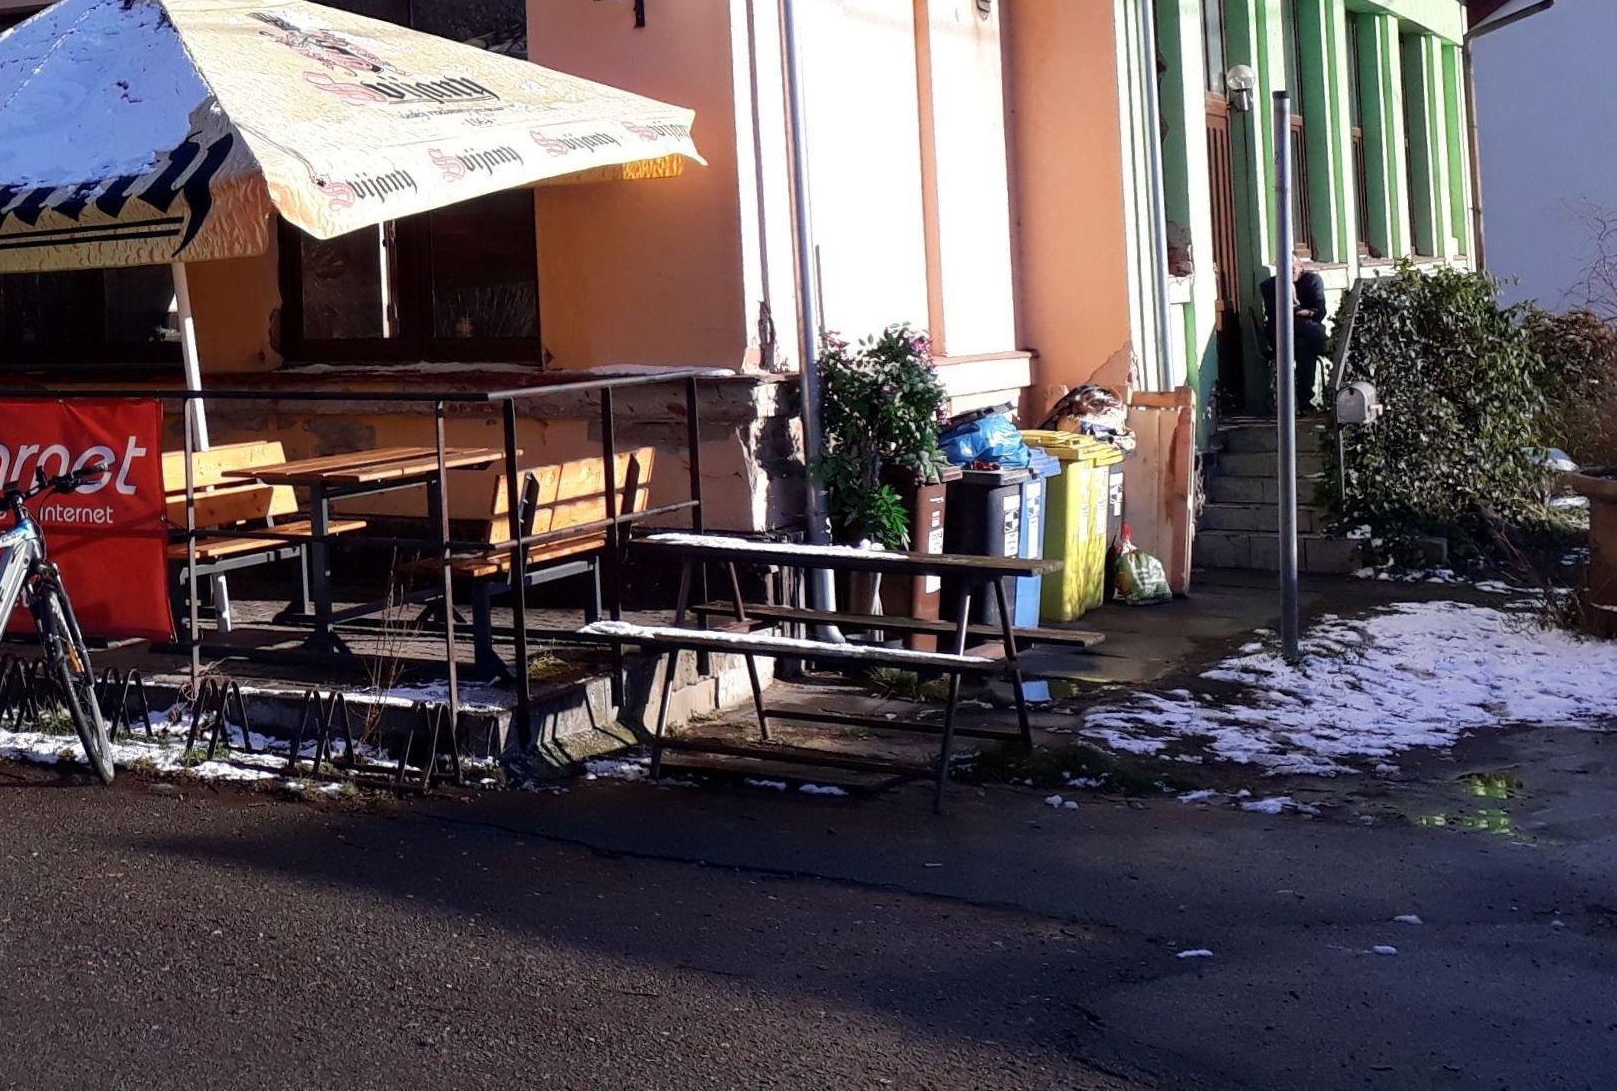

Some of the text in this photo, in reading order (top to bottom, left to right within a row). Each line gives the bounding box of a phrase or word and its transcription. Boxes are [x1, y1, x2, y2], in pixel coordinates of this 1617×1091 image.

[303, 70, 500, 106] Svijany
[530, 130, 621, 157] Svijany
[428, 144, 524, 182] Svijany
[319, 168, 418, 210] Svijany
[40, 505, 113, 524] internet
